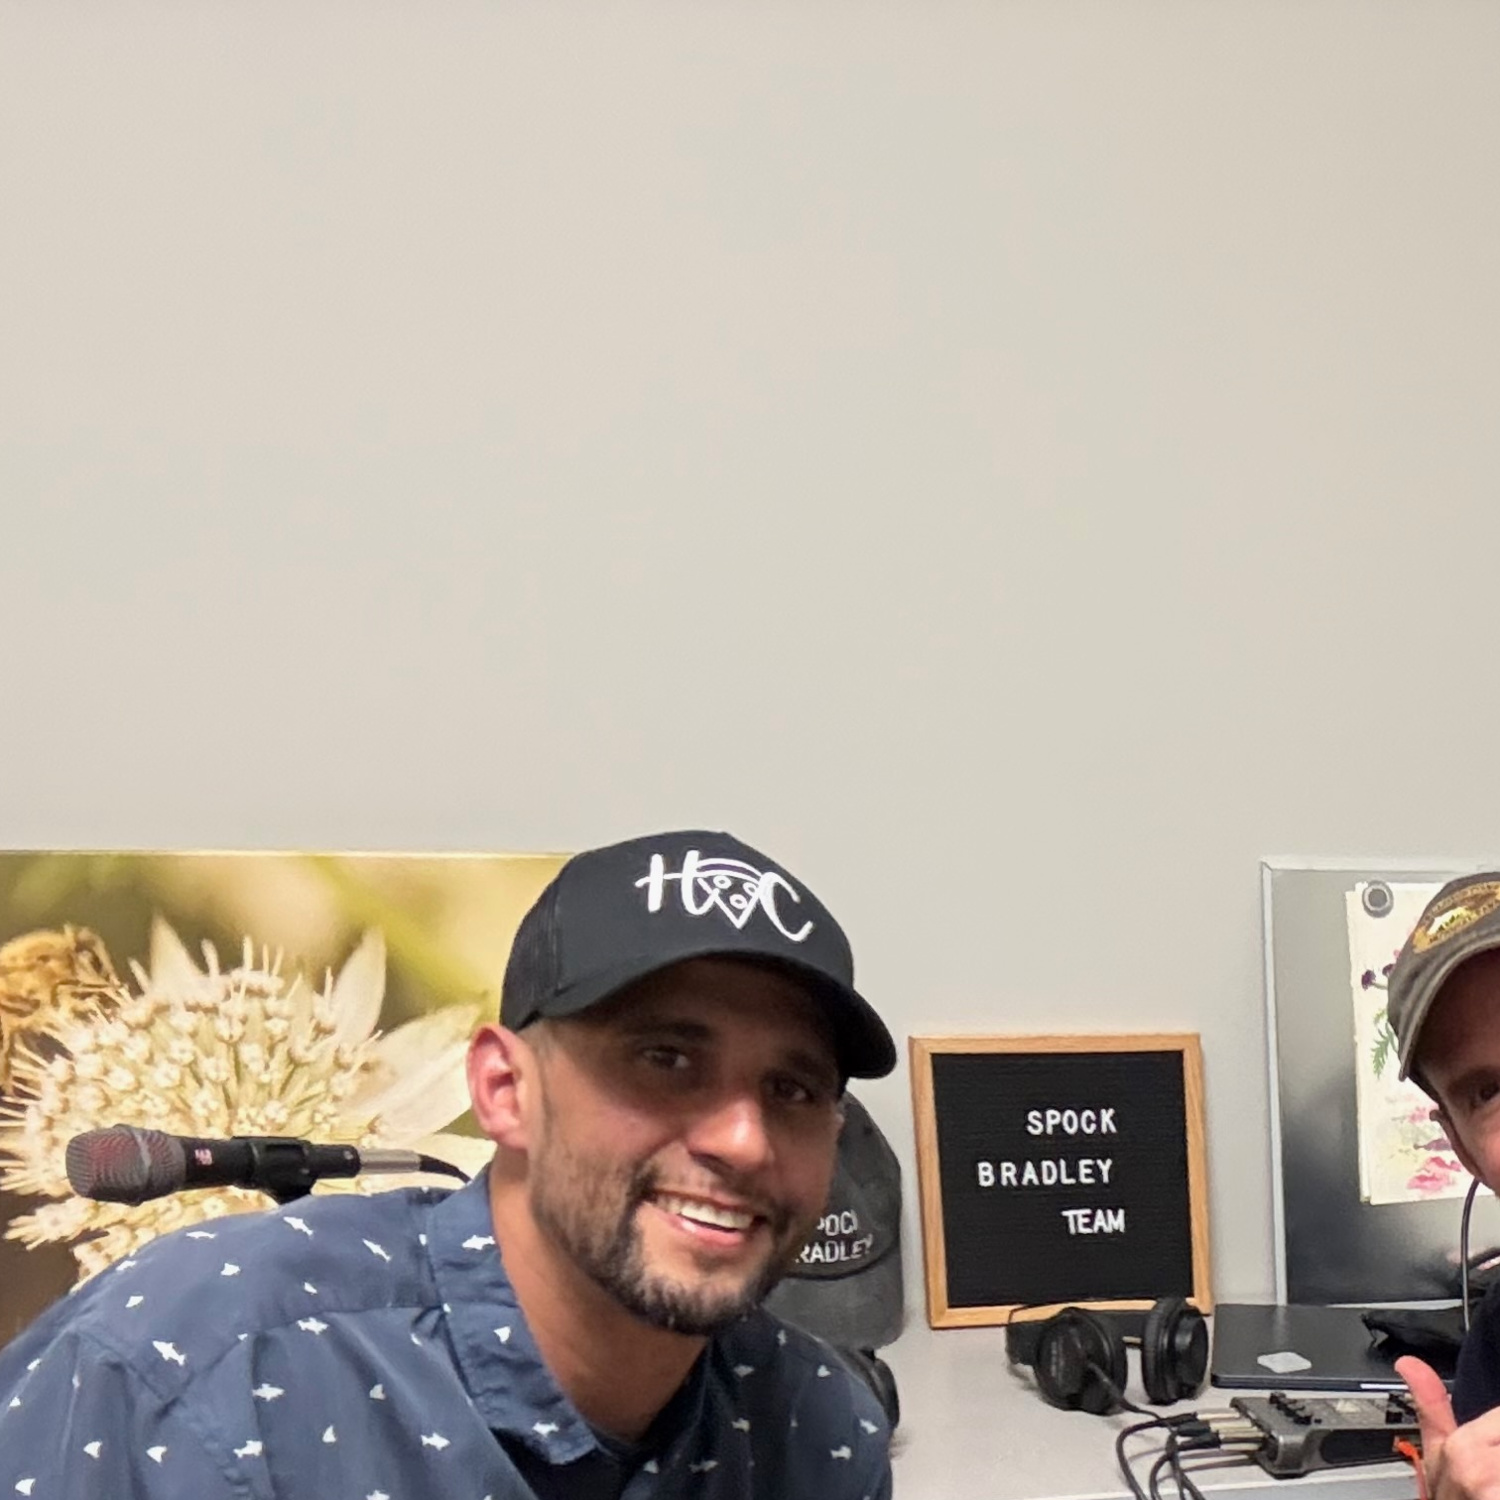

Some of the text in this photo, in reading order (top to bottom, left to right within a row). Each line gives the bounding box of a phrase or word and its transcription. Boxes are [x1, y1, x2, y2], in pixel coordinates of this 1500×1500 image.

[1026, 1108, 1117, 1136] SPOCK
[976, 1158, 1113, 1187] BRADLEY
[1060, 1208, 1126, 1235] TEAM
